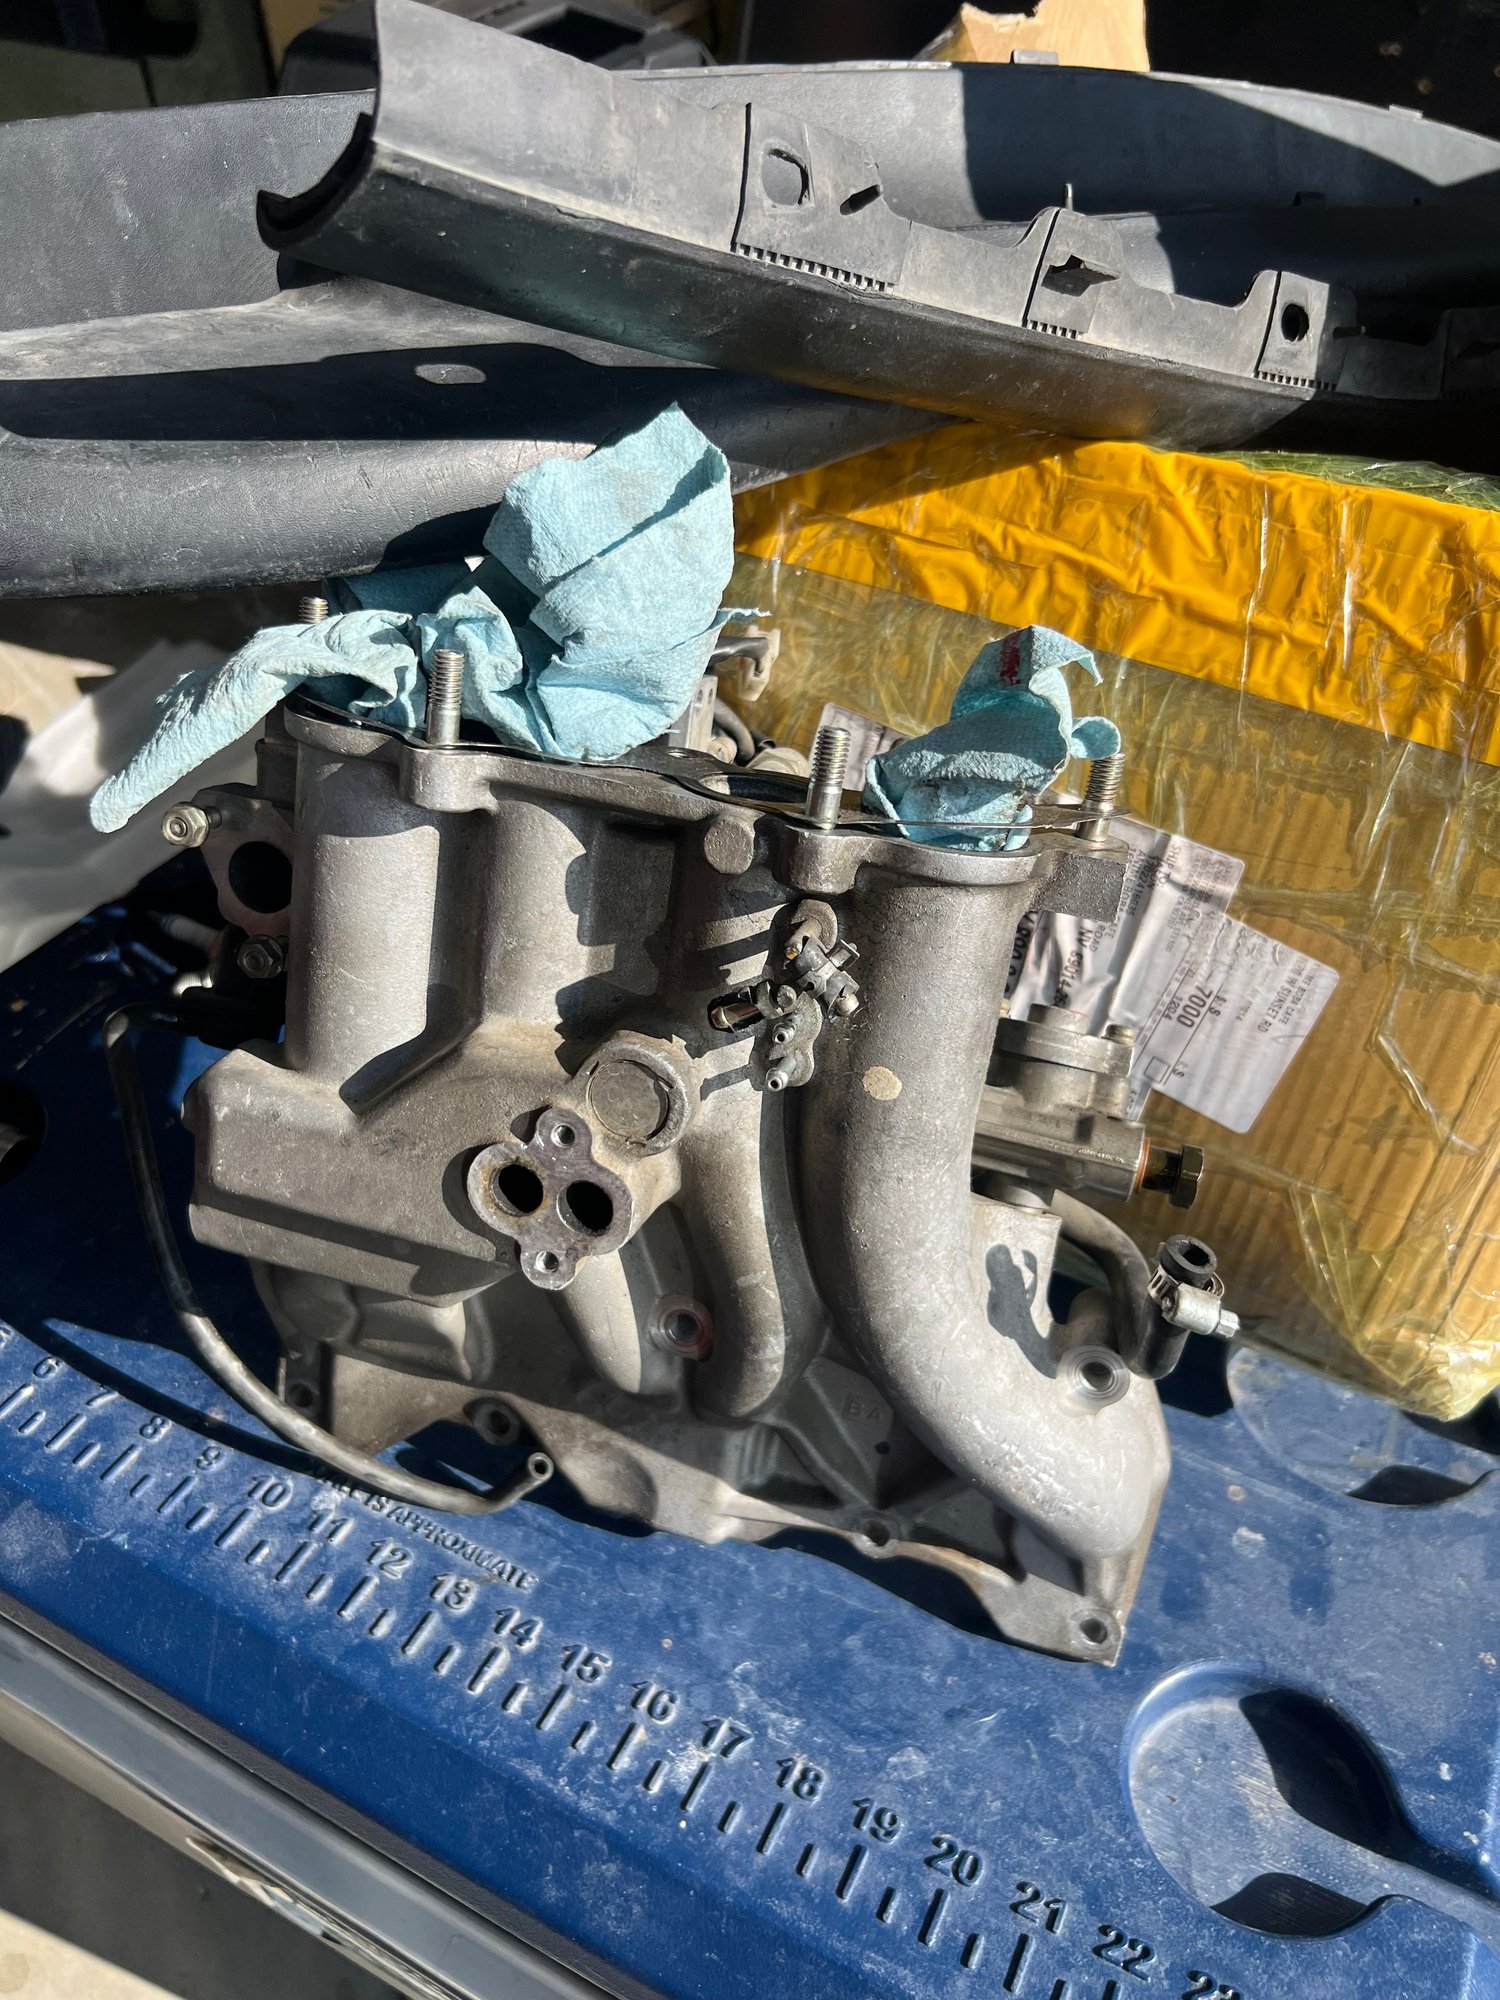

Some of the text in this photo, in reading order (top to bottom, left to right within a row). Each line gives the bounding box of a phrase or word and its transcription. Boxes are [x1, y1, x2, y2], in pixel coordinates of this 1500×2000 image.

[1126, 849, 1146, 885] ANIME
[1164, 844, 1181, 870] SHIP
[1074, 926, 1093, 948] NV
[1175, 982, 1213, 1029] 7000
[1264, 985, 1292, 1020] SUNSET
[1277, 1005, 1295, 1026] CAFE
[1256, 1017, 1272, 1034] RD
[32, 1357, 62, 1380] 6
[139, 1415, 171, 1443] 8
[195, 1445, 228, 1471] 9
[248, 1474, 295, 1515] 10
[308, 1508, 355, 1546] 11
[367, 1537, 414, 1580] 12
[429, 1572, 478, 1615] 13
[494, 1606, 544, 1653] 14
[561, 1644, 613, 1684] 15
[630, 1680, 680, 1725] 16
[702, 1716, 753, 1760] 17
[776, 1755, 825, 1803] 18
[853, 1797, 902, 1843] 19
[923, 1834, 985, 1888] 20
[1008, 1881, 1067, 1933] 21
[1091, 1923, 1156, 1983] 22
